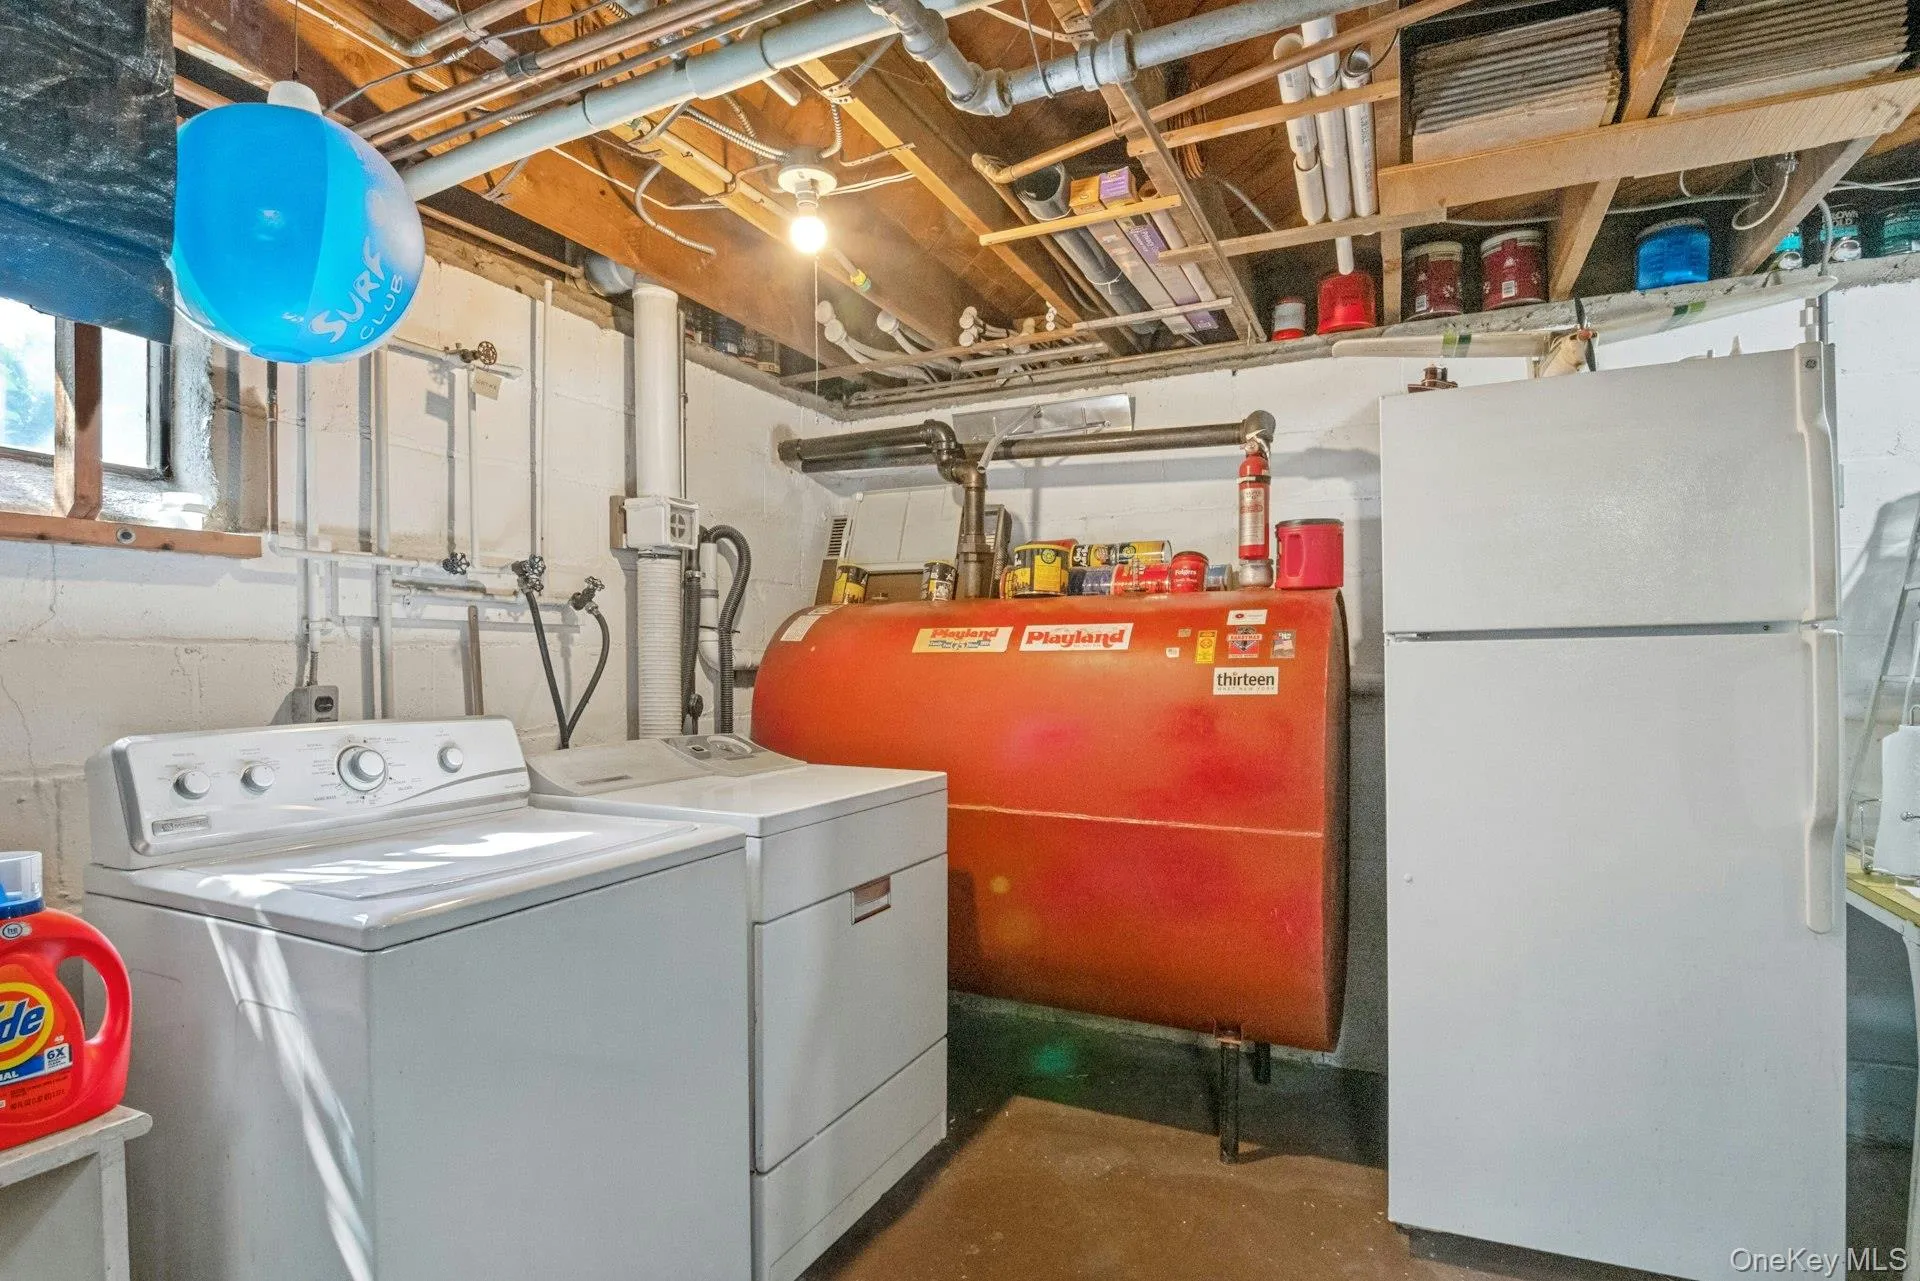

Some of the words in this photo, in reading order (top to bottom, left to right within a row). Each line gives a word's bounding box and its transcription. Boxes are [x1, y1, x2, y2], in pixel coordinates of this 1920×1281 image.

[308, 235, 385, 344] SURF
[360, 274, 403, 340] CLUB
[931, 628, 999, 641] Playland
[1026, 629, 1126, 648] Playland
[1217, 672, 1275, 686] thirteen
[47, 1047, 65, 1059] 6X
